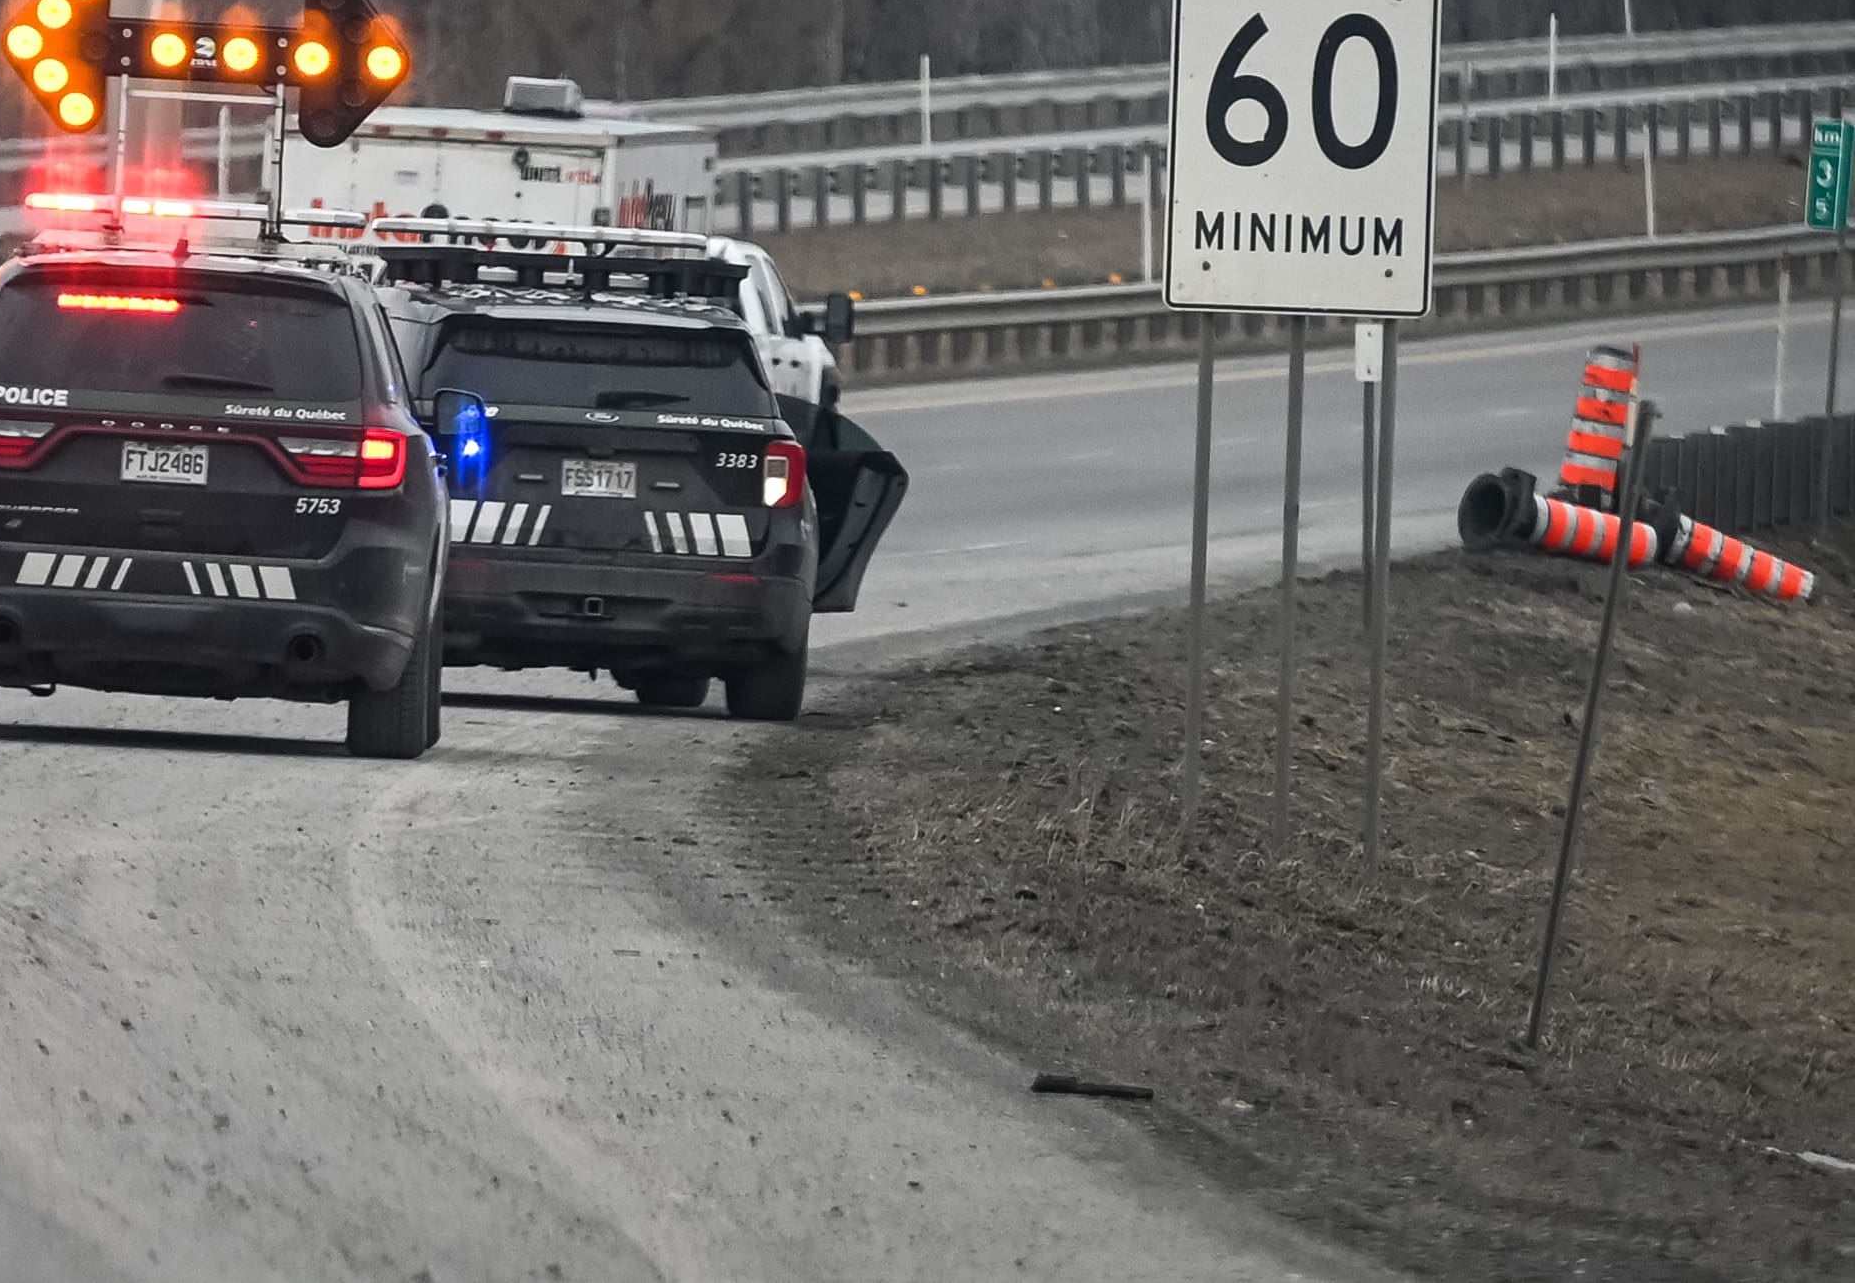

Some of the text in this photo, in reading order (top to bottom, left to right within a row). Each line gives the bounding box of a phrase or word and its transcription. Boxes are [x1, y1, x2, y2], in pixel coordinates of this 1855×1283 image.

[1205, 12, 1399, 171] 60
[1814, 127, 1840, 143] km
[1194, 211, 1404, 258] MINIMUM
[224, 403, 347, 422] Sûreté du Québec
[701, 417, 719, 427] du
[720, 418, 765, 432] Québec
[124, 450, 205, 477] FTJ2486
[715, 452, 759, 469] 3383
[296, 497, 342, 516] 5753
